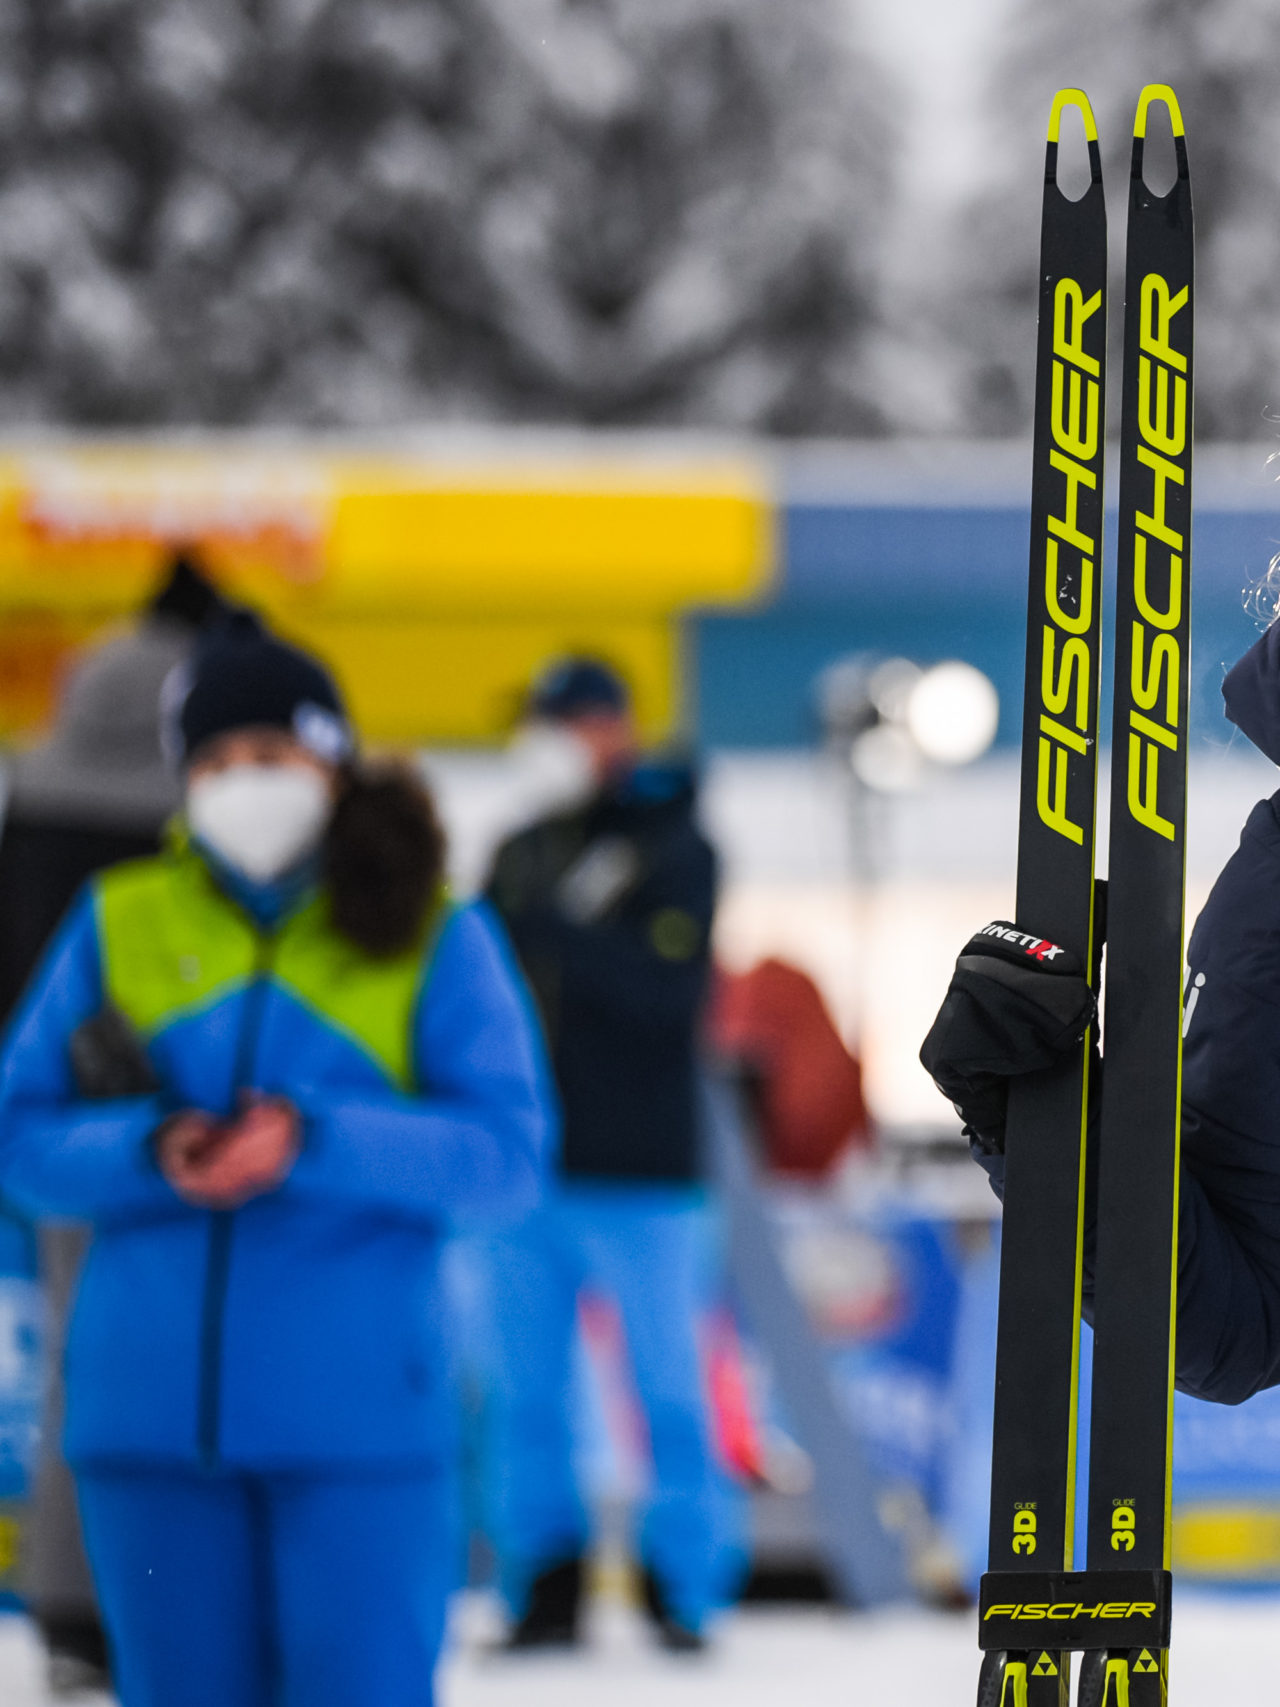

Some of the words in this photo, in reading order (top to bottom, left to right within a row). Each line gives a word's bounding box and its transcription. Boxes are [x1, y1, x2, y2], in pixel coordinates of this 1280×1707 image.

[1036, 277, 1102, 846] FISCHER
[1127, 273, 1189, 842] FISCHER
[1014, 1502, 1037, 1510] GLIDE
[1112, 1498, 1136, 1507] GLIDE
[1012, 1510, 1037, 1556] 3D
[1111, 1506, 1136, 1552] 3D
[984, 1602, 1157, 1621] FISCHER
